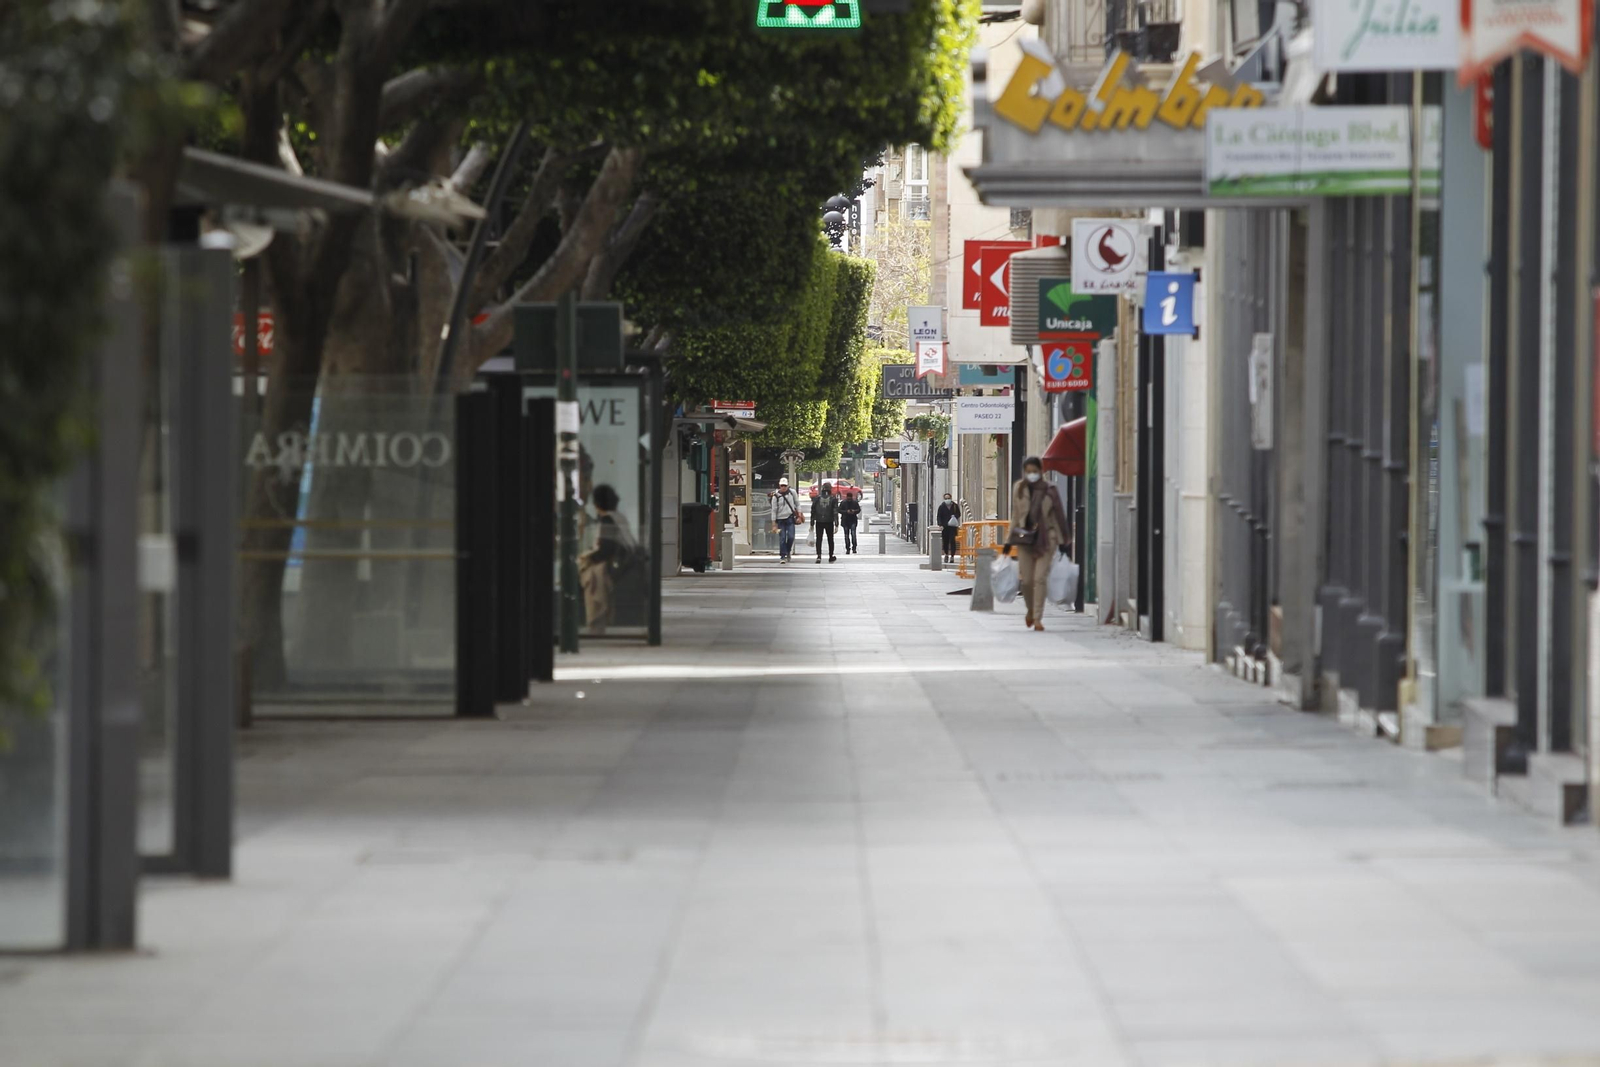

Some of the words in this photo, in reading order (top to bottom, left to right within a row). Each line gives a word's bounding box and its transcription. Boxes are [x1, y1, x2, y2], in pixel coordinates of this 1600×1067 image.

[1215, 122, 1243, 145] La
[1046, 317, 1093, 331] Unicaja
[1047, 380, 1067, 388] EURO
[578, 398, 626, 426] WE
